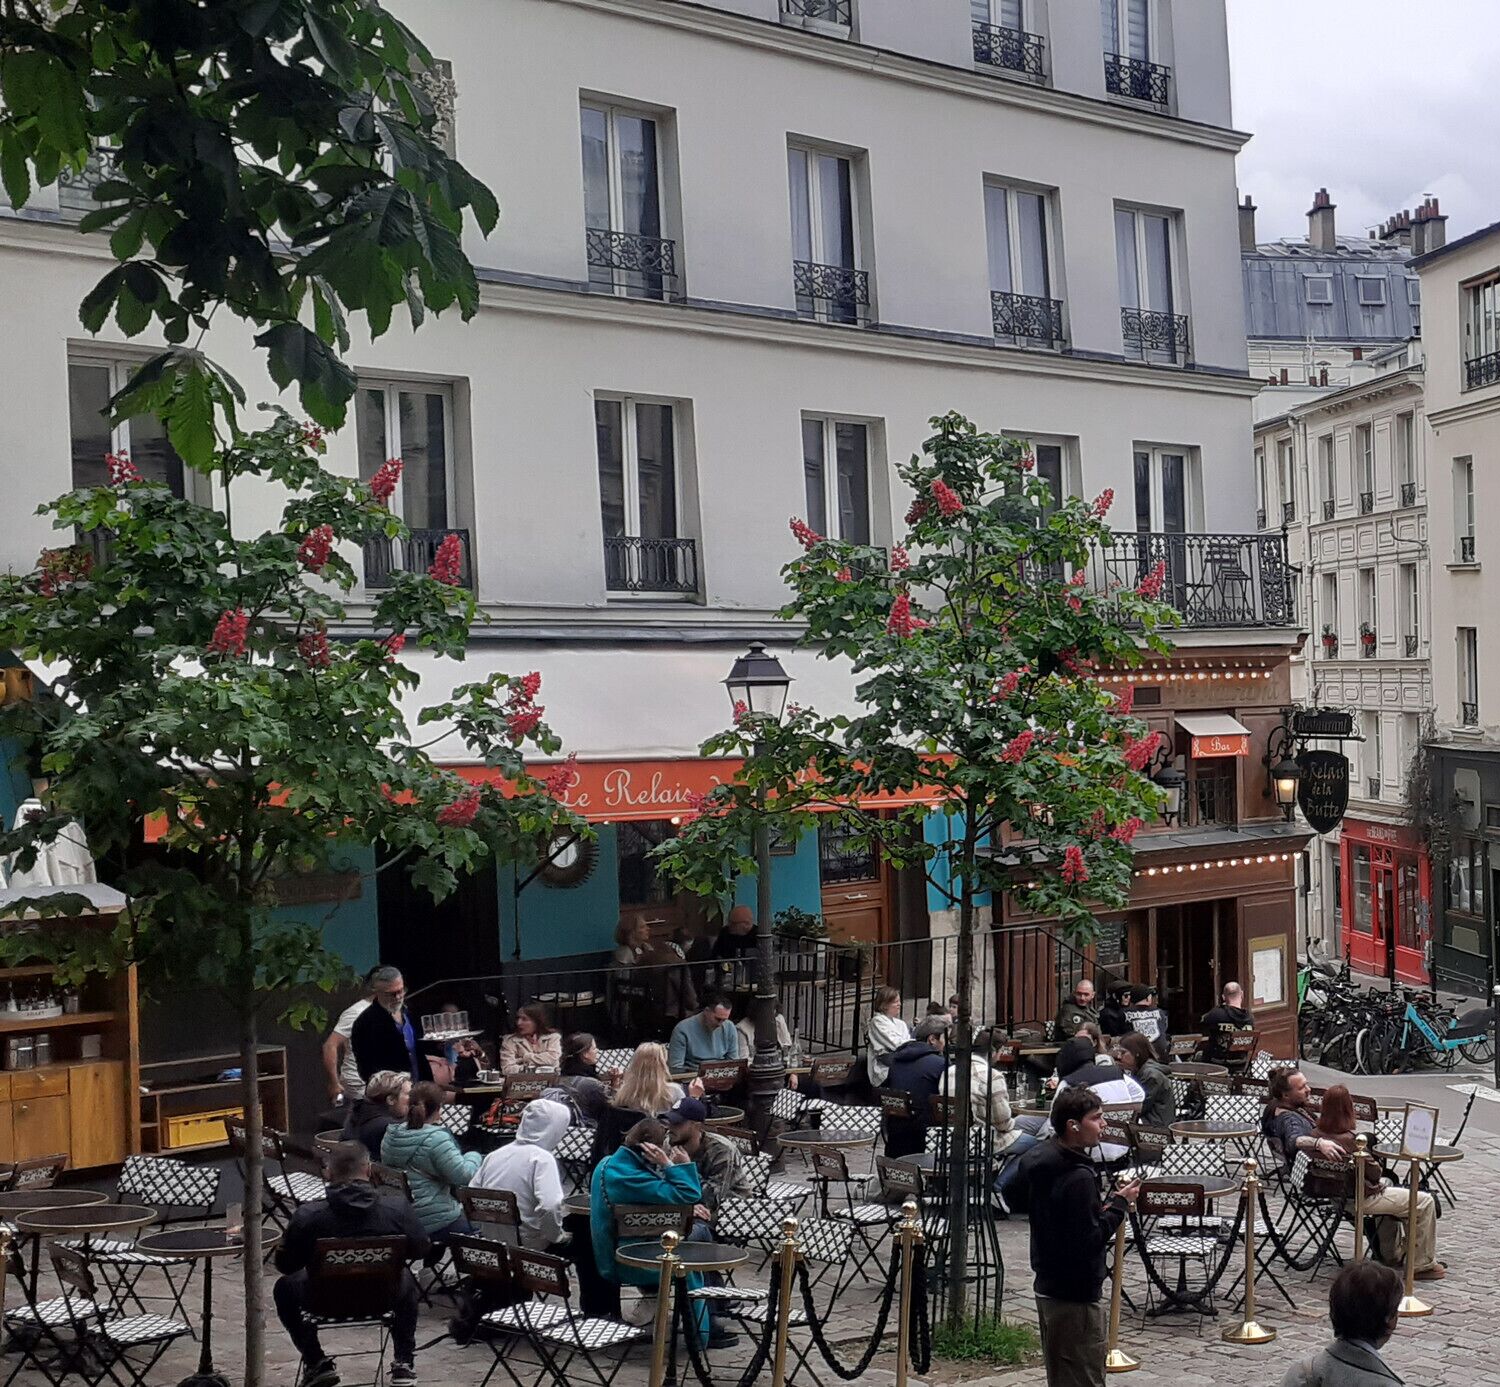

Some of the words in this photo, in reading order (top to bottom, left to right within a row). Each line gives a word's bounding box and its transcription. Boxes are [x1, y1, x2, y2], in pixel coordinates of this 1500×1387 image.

[1298, 718, 1348, 733] Restaurant
[1211, 736, 1230, 751] Bar
[1309, 760, 1345, 779] Relais
[604, 768, 692, 806] Relais
[1311, 782, 1320, 795] de
[1306, 797, 1339, 818] Butte
[1419, 1022, 1437, 1041] TIER
